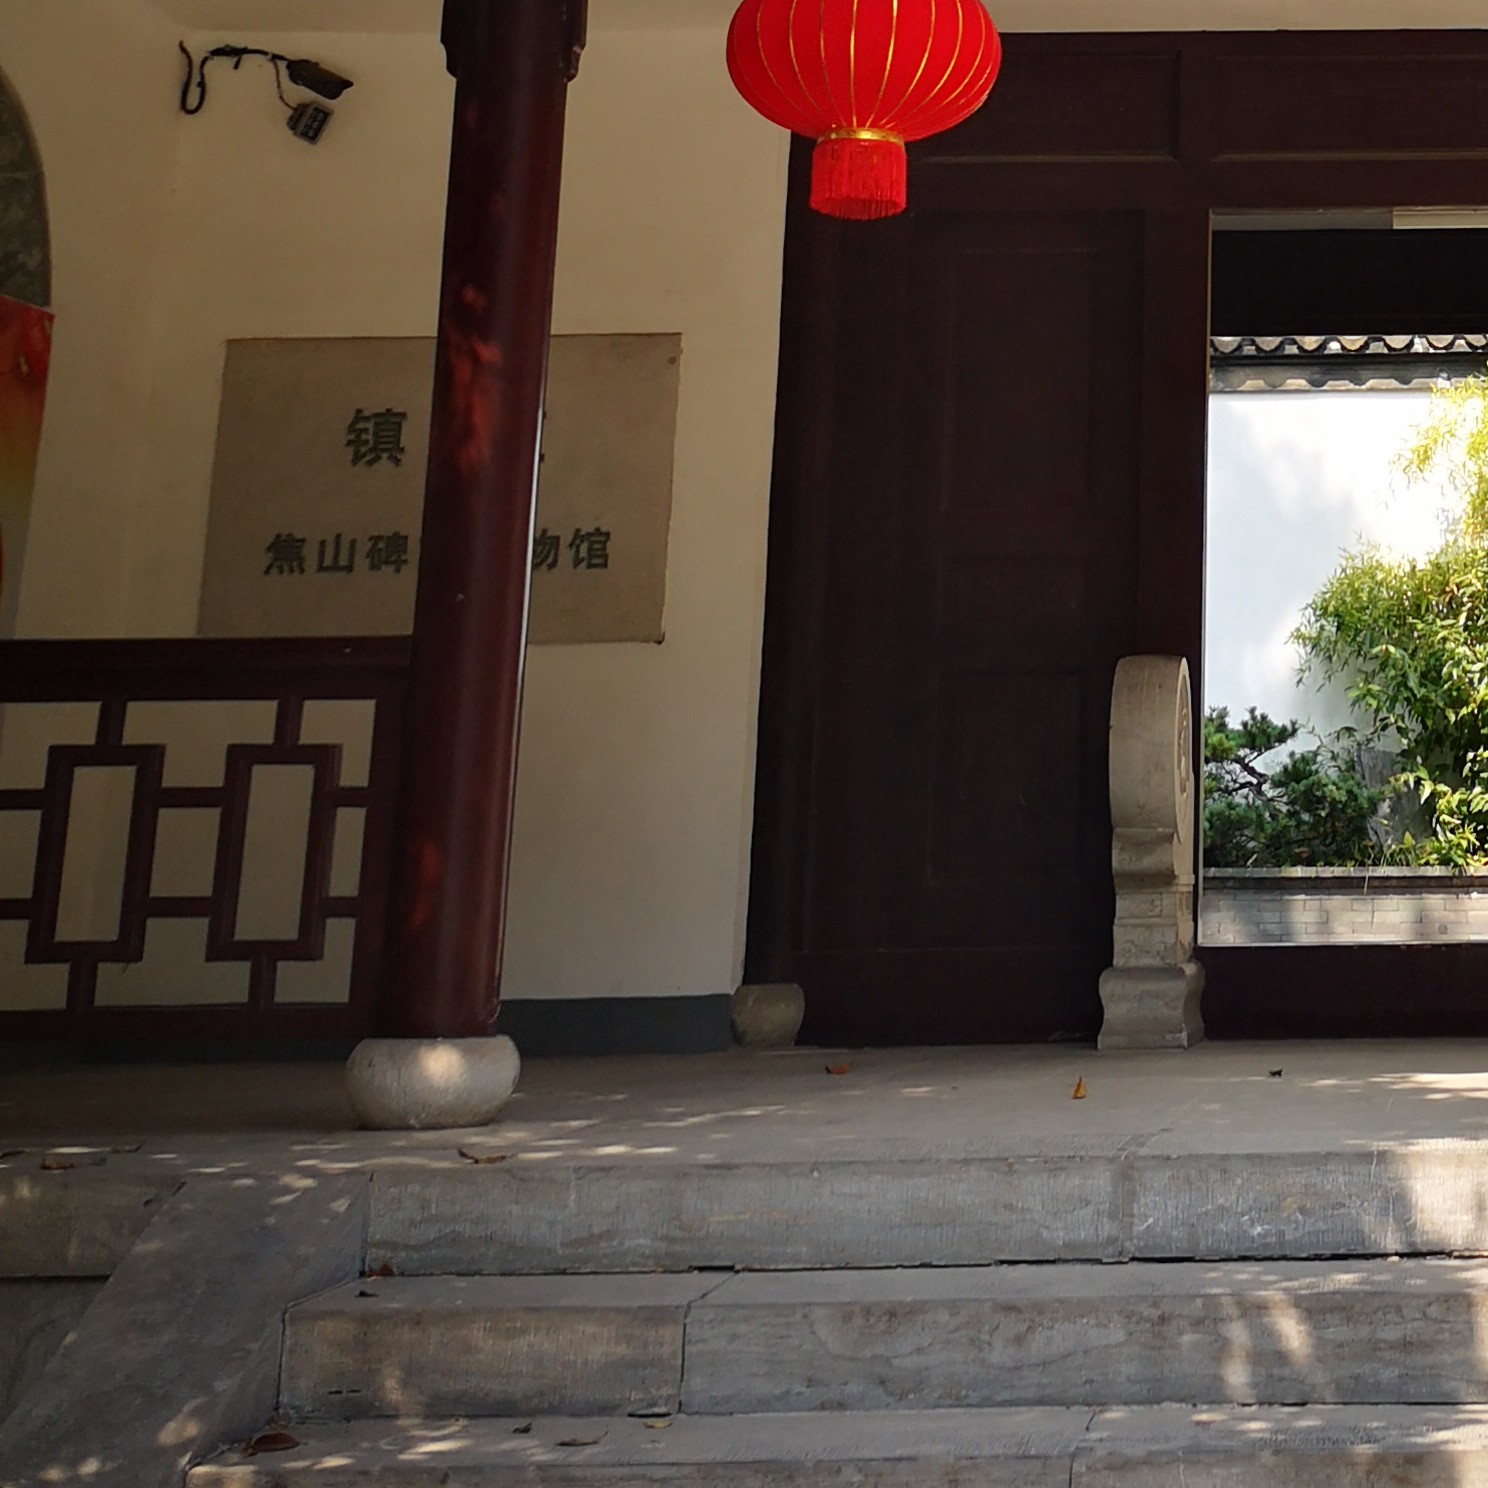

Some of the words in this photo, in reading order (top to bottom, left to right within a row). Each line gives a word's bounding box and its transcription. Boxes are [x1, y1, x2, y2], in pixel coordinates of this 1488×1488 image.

[263, 527, 612, 575] 焦山碑物馆
